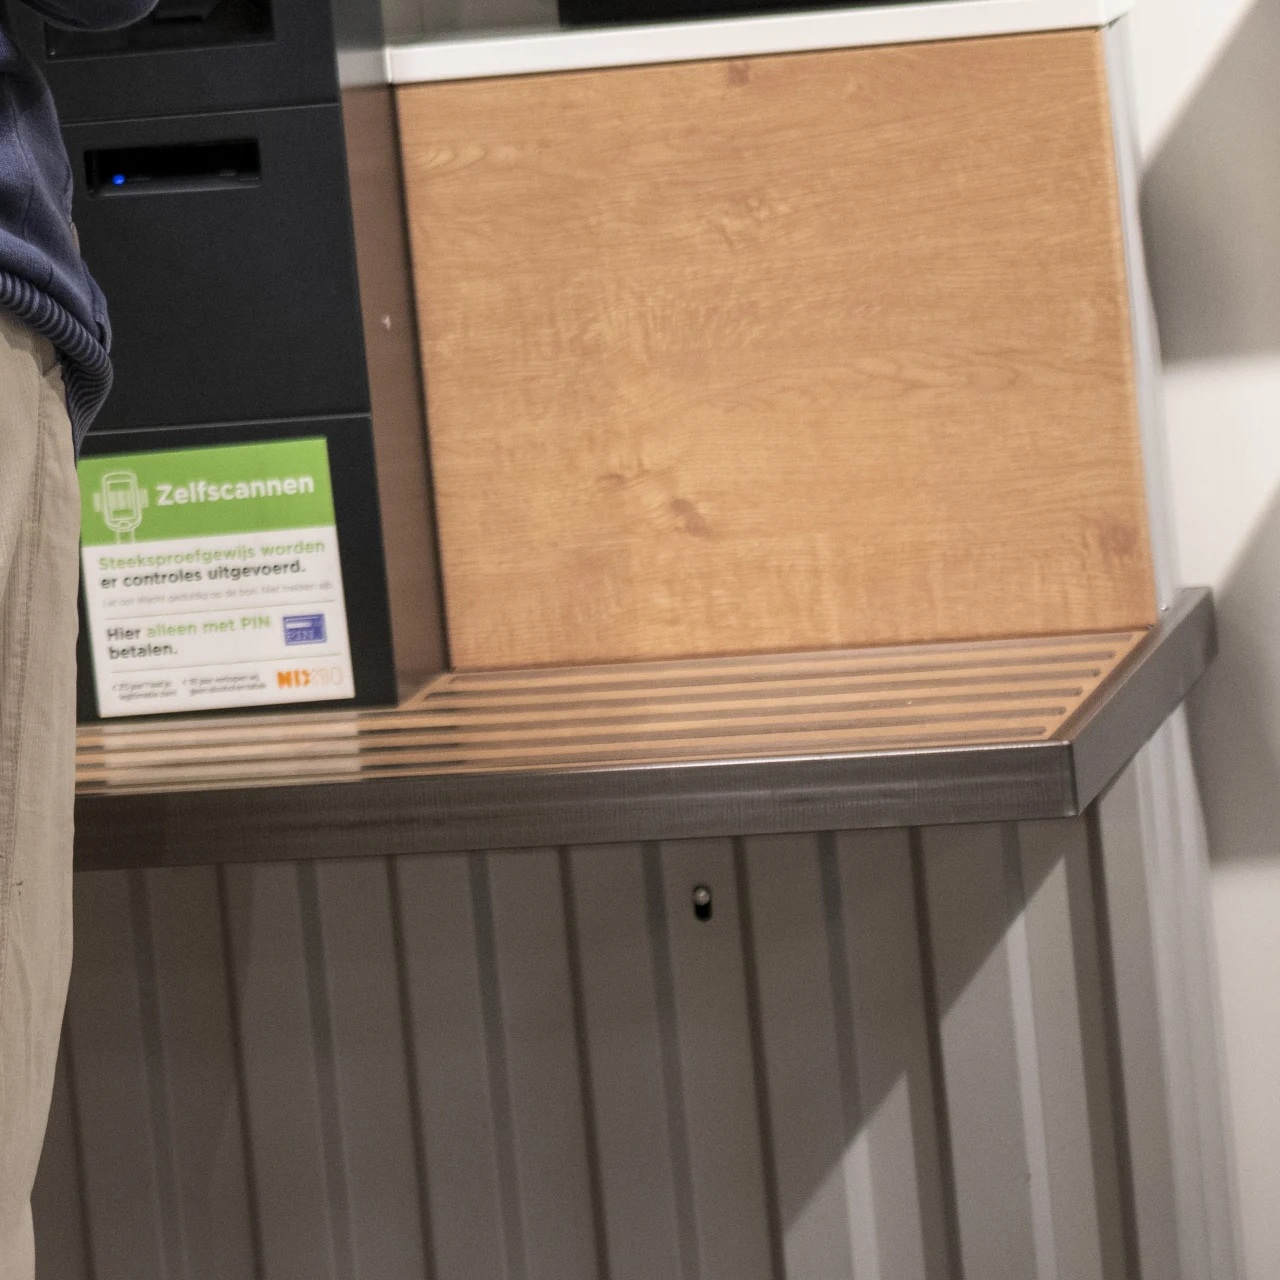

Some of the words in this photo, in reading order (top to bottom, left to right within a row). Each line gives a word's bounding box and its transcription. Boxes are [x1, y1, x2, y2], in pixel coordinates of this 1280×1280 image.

[155, 476, 314, 506] Zelfscannen
[98, 546, 255, 571] Steeksproefgewijs
[261, 540, 325, 557] worden
[100, 576, 117, 590] er
[123, 569, 202, 588] controles
[207, 560, 306, 581] uitgevoerd.
[107, 627, 141, 642] Hier
[147, 619, 197, 638] alleen
[203, 618, 234, 634] met
[240, 615, 272, 631] PIN
[108, 642, 178, 660] betalen.
